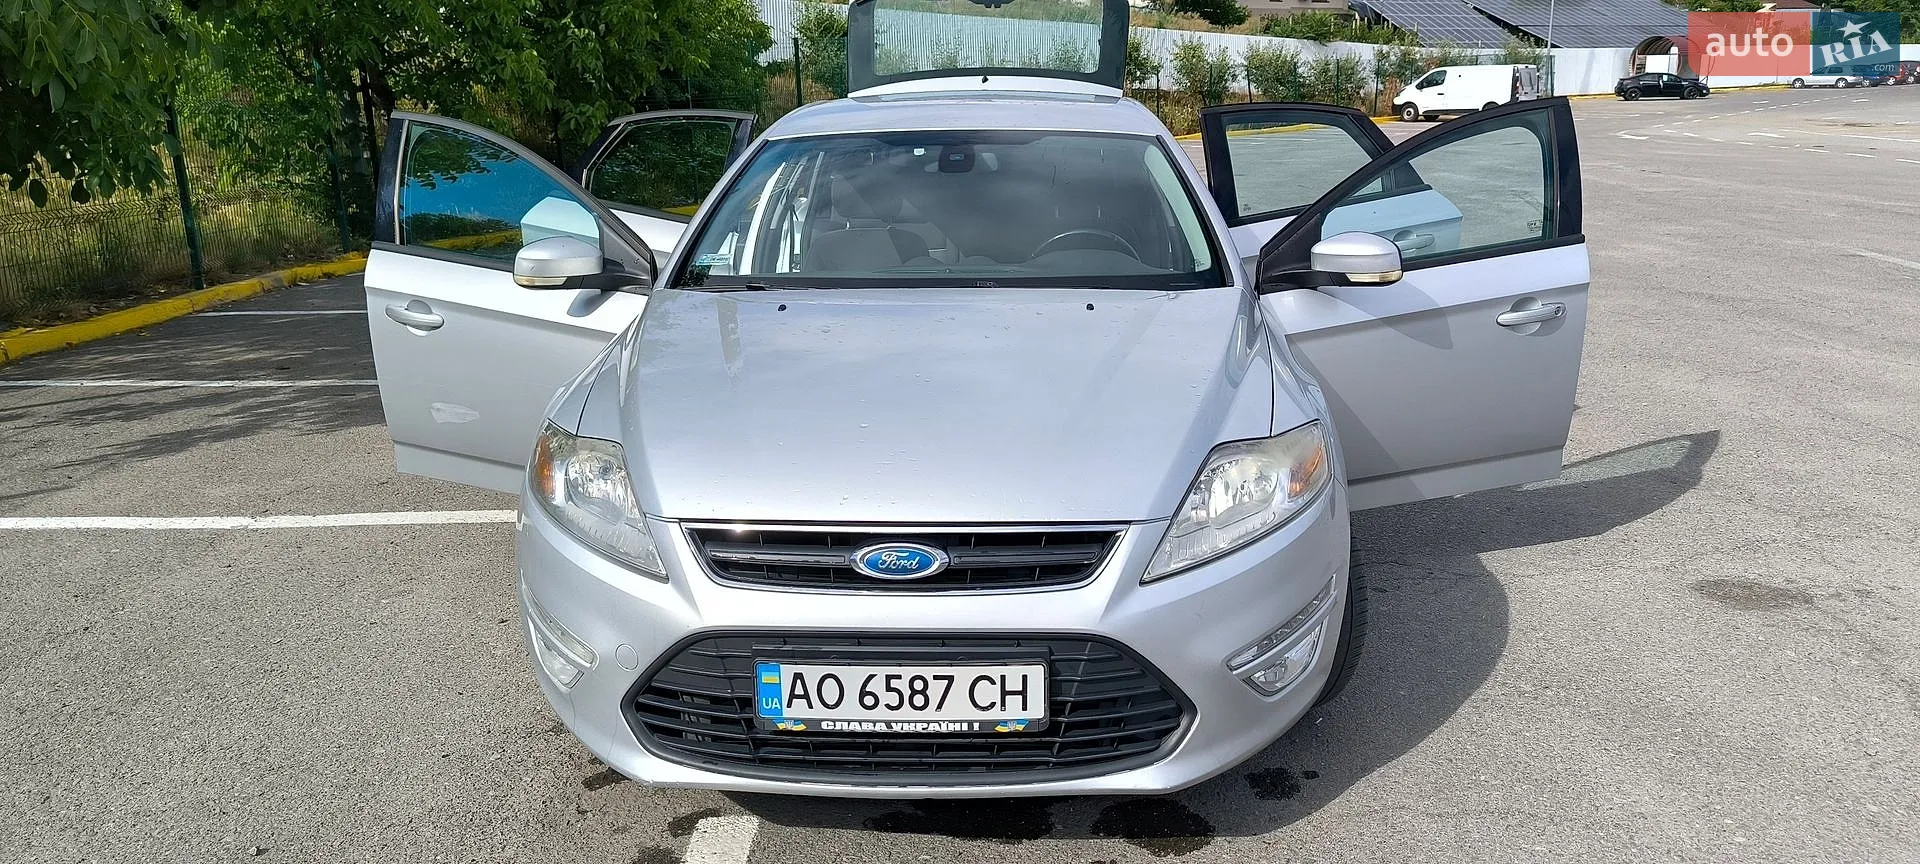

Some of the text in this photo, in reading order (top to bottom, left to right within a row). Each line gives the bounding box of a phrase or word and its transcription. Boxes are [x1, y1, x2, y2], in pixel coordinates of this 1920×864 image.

[878, 551, 920, 569] Ford
[786, 672, 1028, 711] AO 6587 CH
[762, 697, 781, 710] UA
[821, 720, 888, 731] СЛАВА
